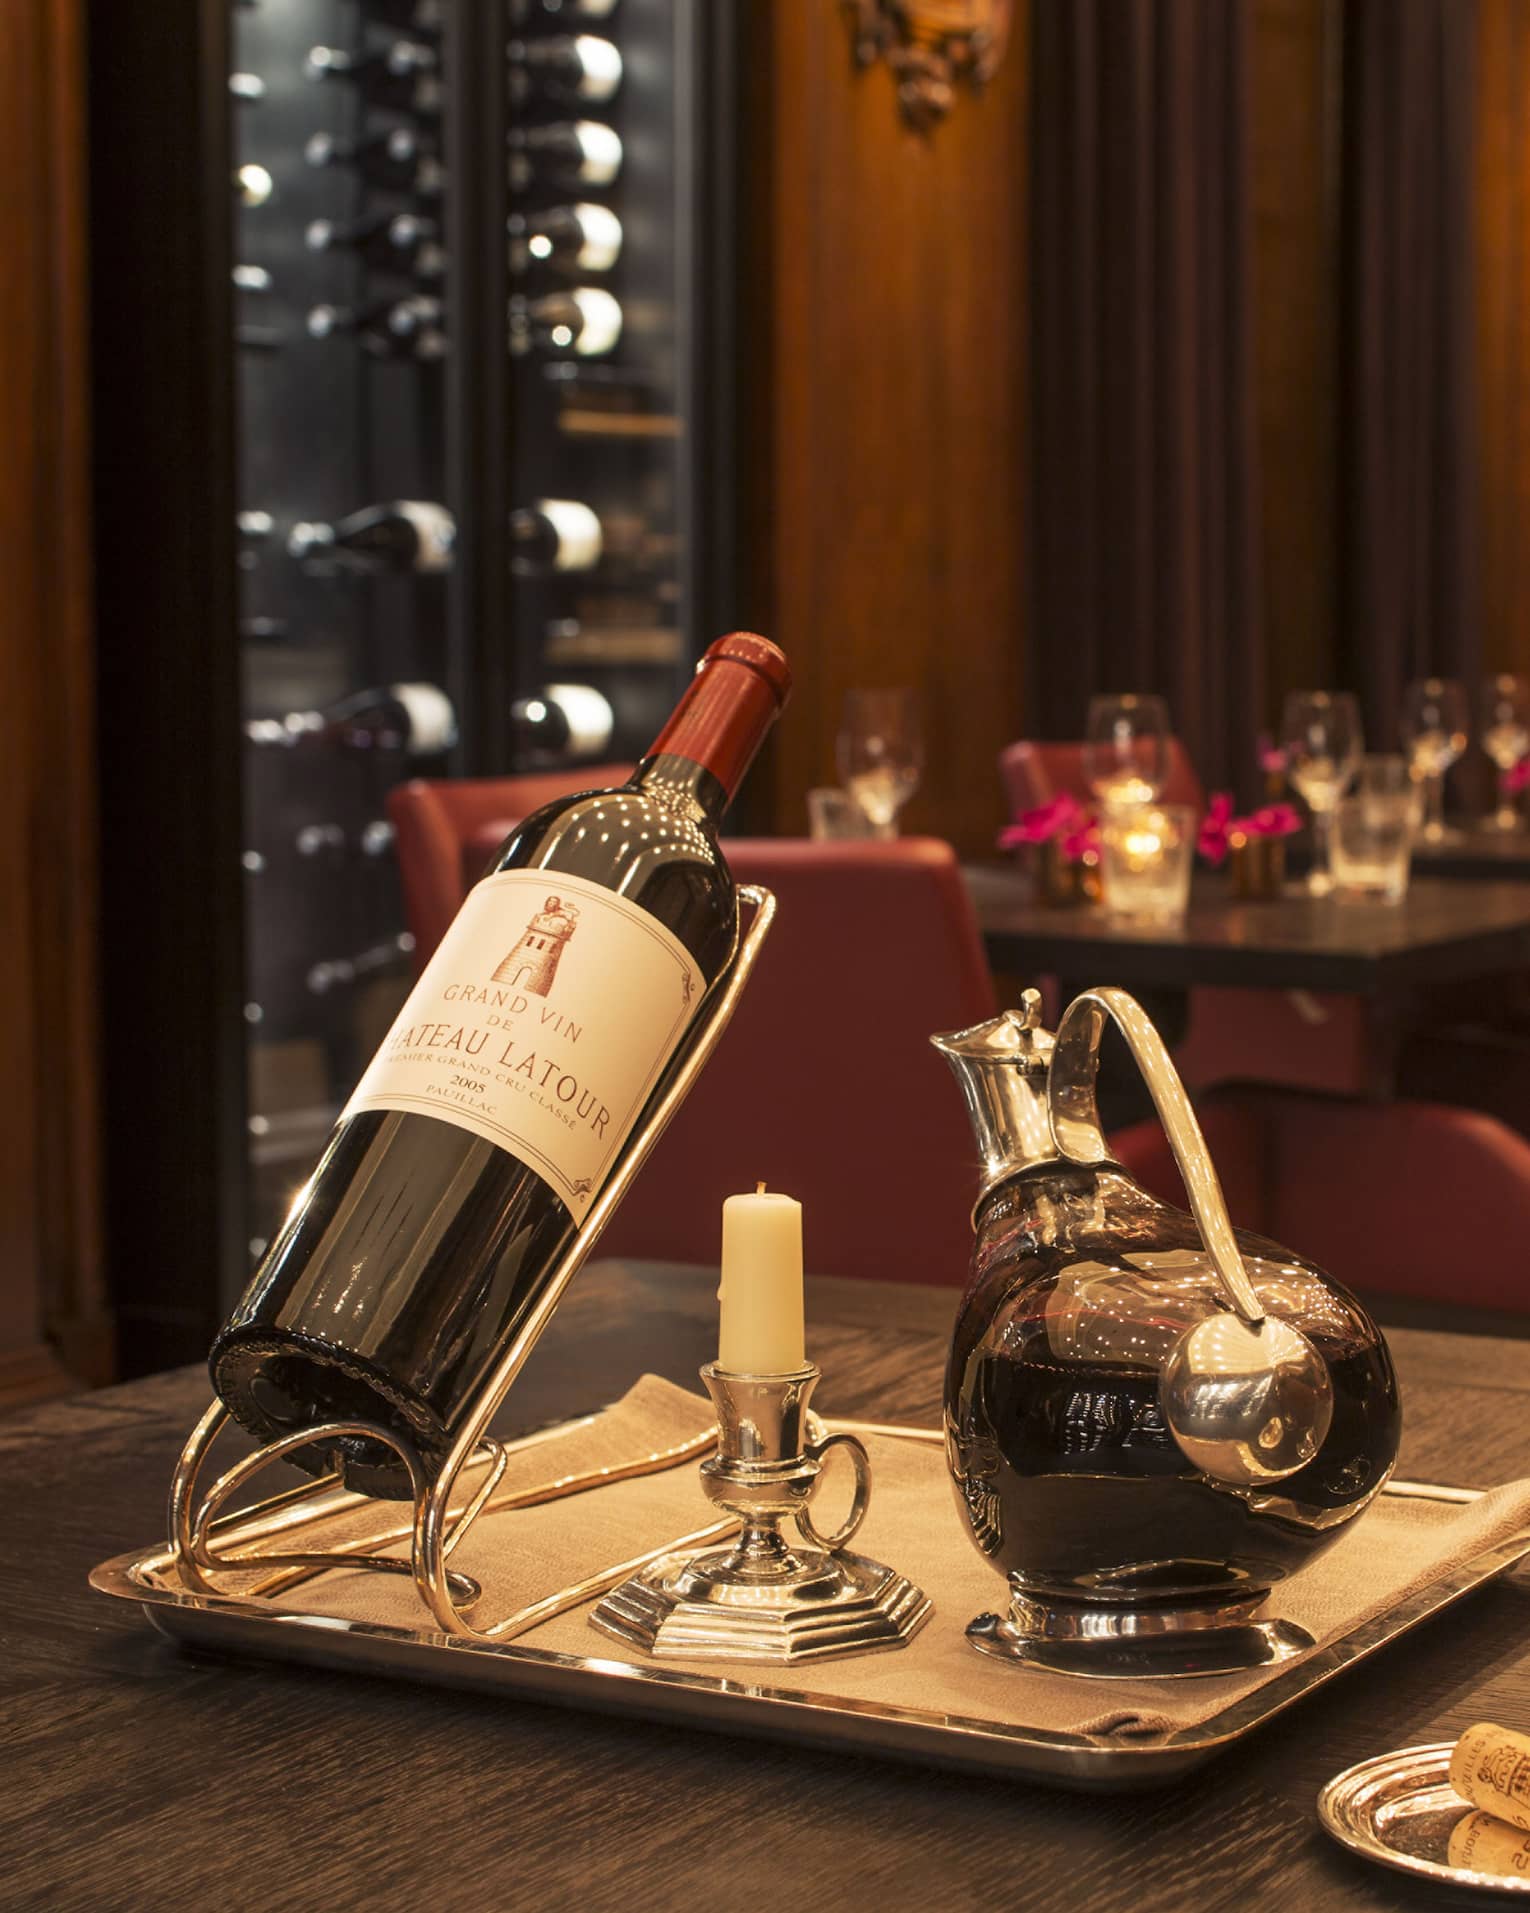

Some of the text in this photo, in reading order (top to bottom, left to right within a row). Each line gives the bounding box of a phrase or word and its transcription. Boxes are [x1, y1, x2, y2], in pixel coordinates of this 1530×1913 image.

[443, 984, 582, 1043] GRAND VIN
[486, 1014, 514, 1031] DE
[388, 1023, 610, 1140] HATEAU LATOUR
[437, 1055, 490, 1076] GRAND
[495, 1073, 526, 1092] CRU
[449, 1074, 486, 1093] 2005
[425, 1084, 497, 1115] PAUILLAC
